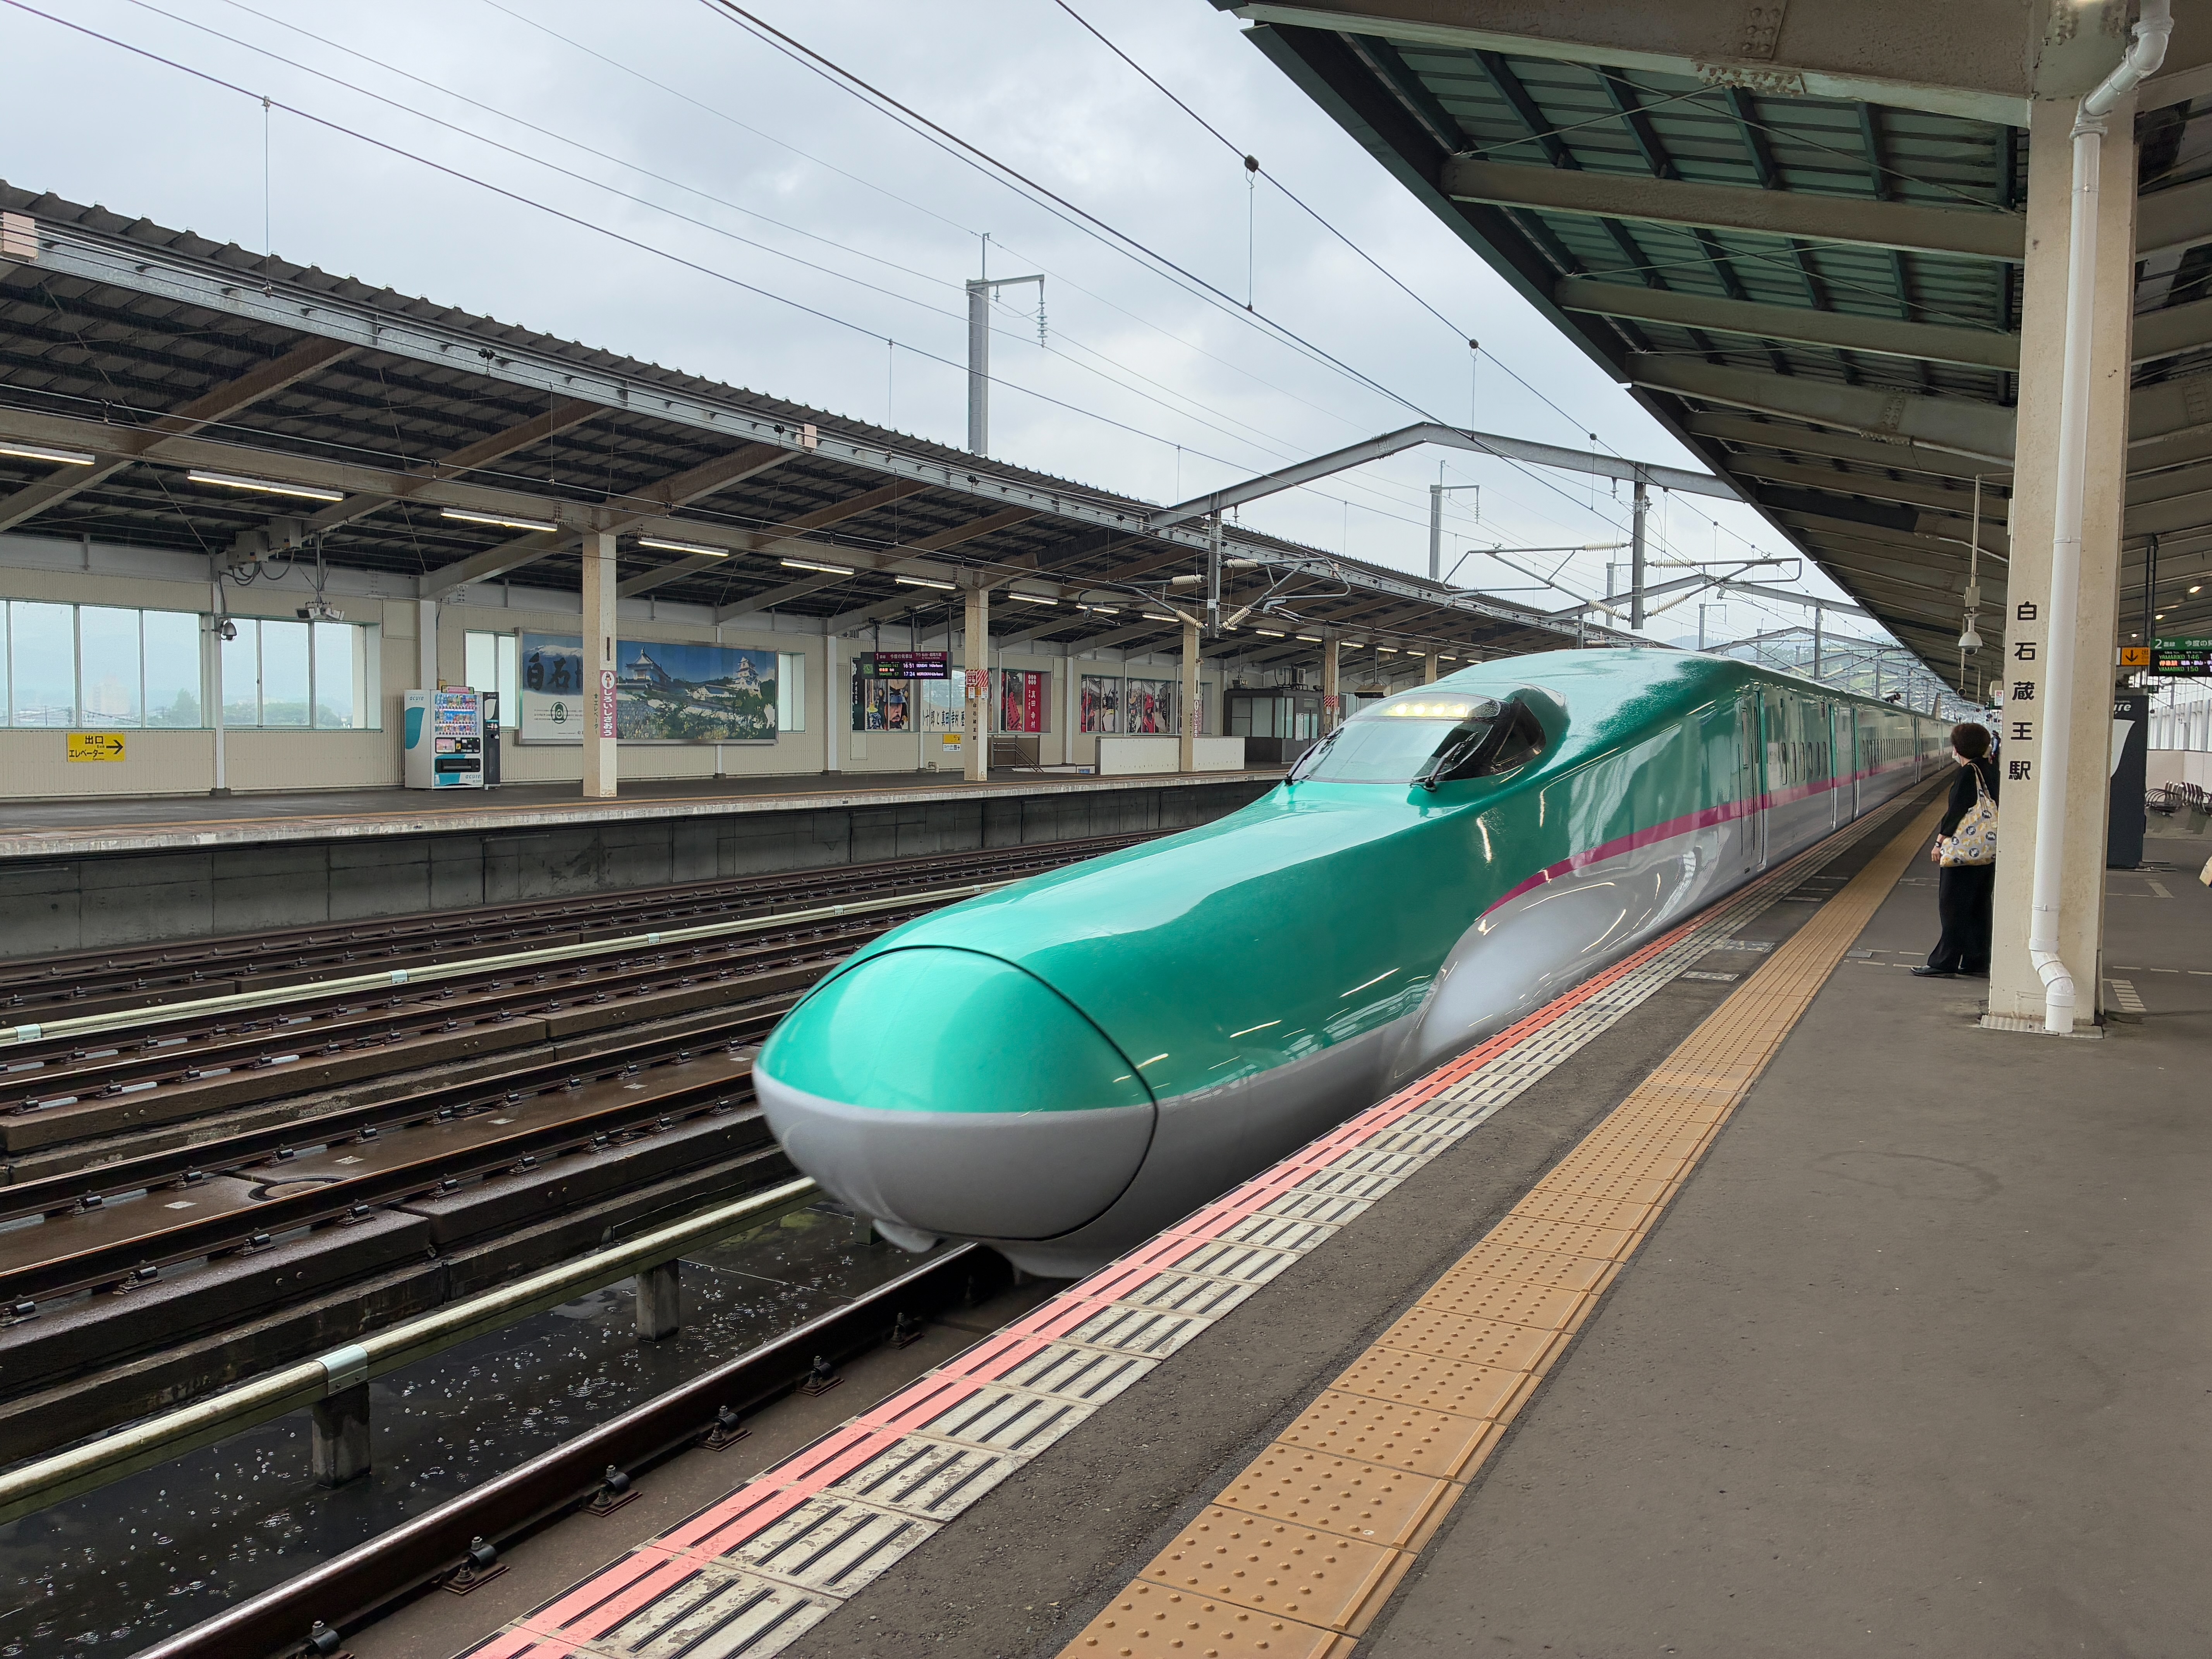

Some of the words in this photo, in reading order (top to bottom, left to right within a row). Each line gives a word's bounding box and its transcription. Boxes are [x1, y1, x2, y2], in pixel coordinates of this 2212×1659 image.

[2008, 601, 2037, 780] 白石蔵王駅
[603, 689, 613, 737] しろいしざおう
[69, 749, 104, 757] エレベーター
[85, 735, 103, 744] 出口
